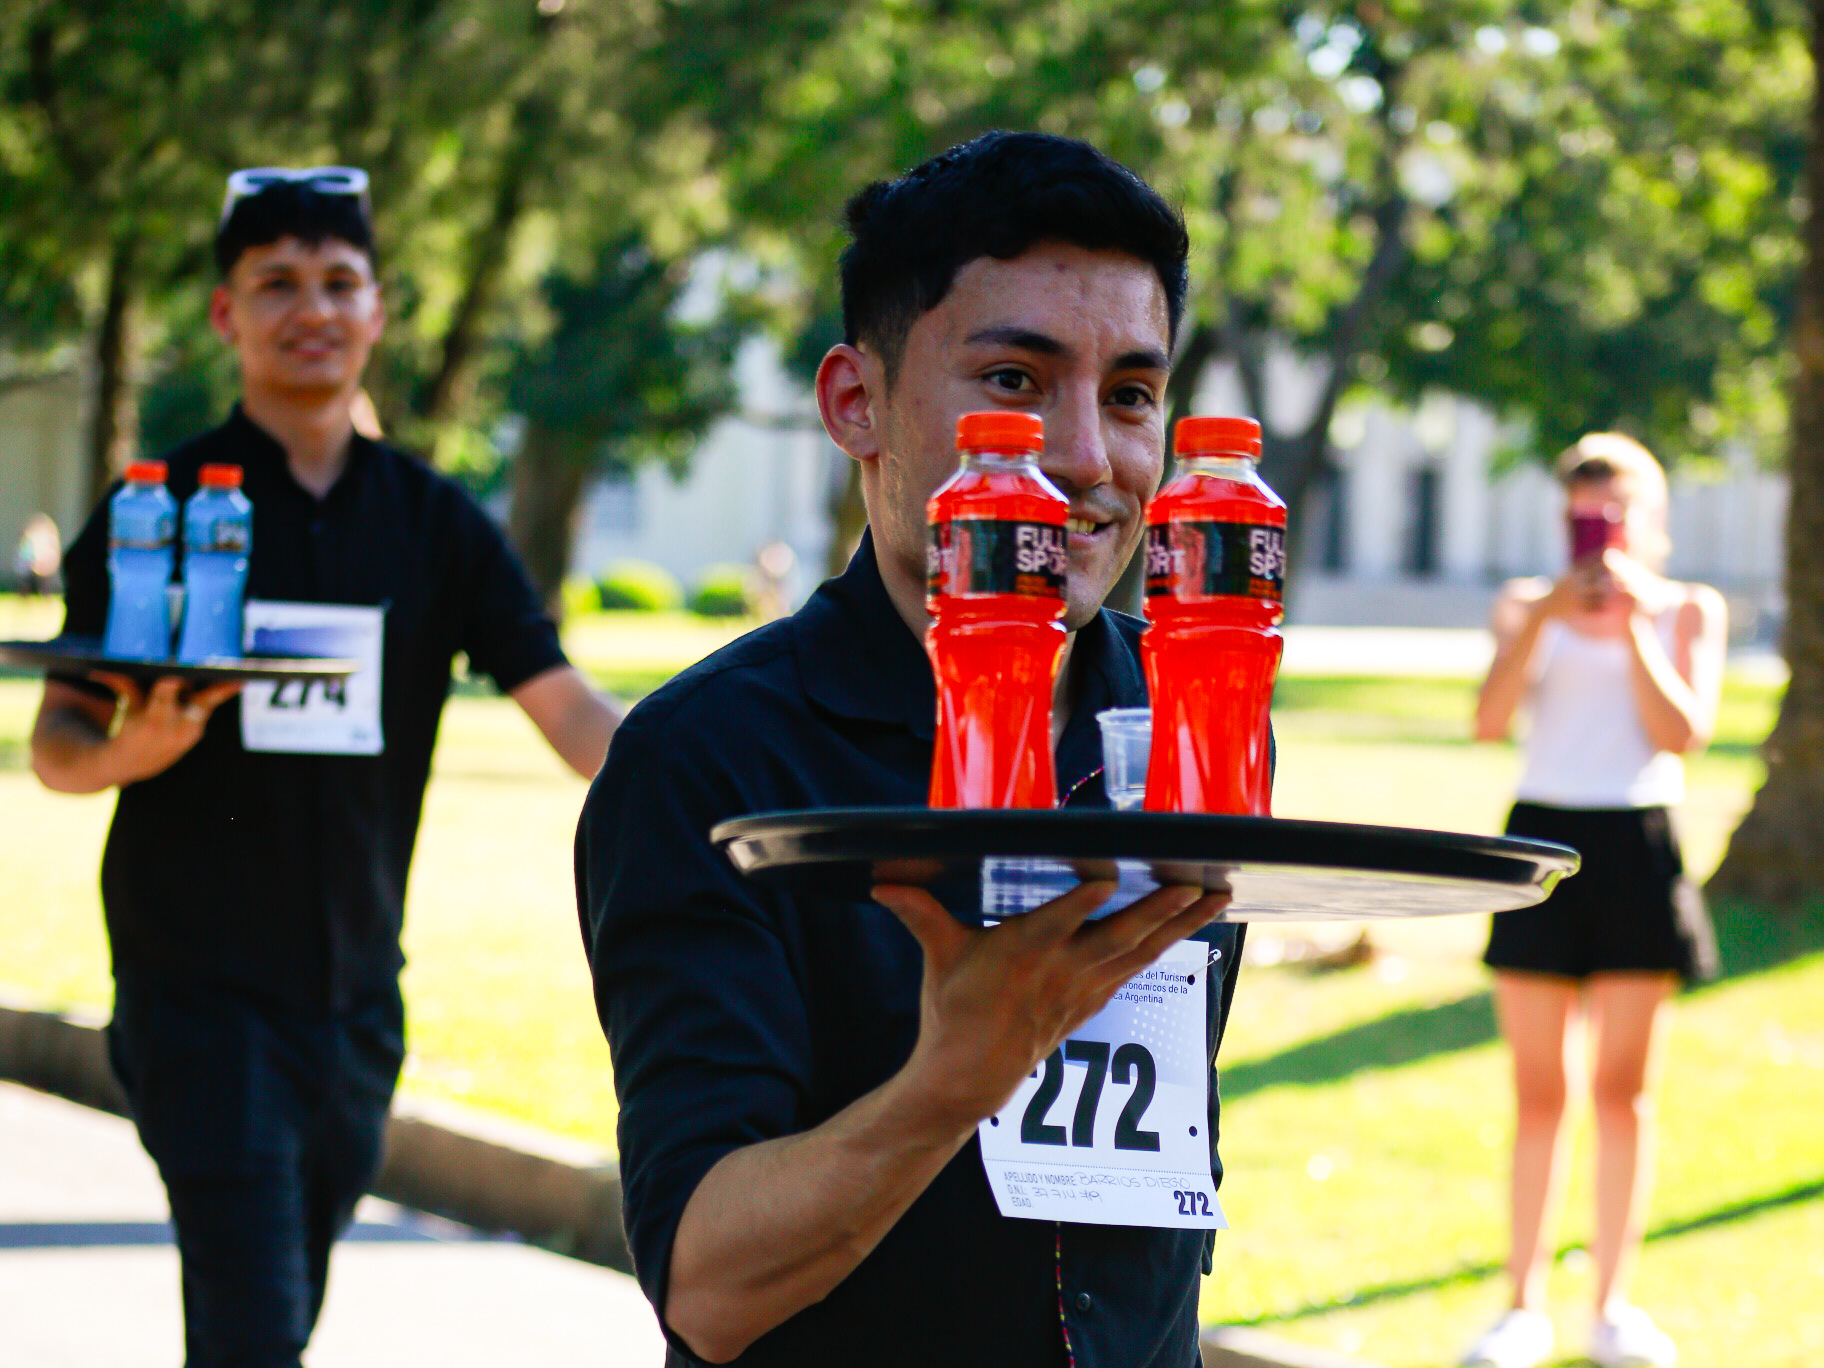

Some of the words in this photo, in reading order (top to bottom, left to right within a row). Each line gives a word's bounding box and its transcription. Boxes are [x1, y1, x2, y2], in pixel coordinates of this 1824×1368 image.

[1145, 970, 1158, 980] del
[1160, 972, 1188, 983] Turism
[1168, 984, 1179, 994] de
[1180, 985, 1188, 994] la
[1124, 991, 1163, 1004] Argentina
[1021, 1039, 1160, 1152] 272
[1004, 1171, 1038, 1184] APELLIDO
[1173, 1190, 1214, 1216] 272
